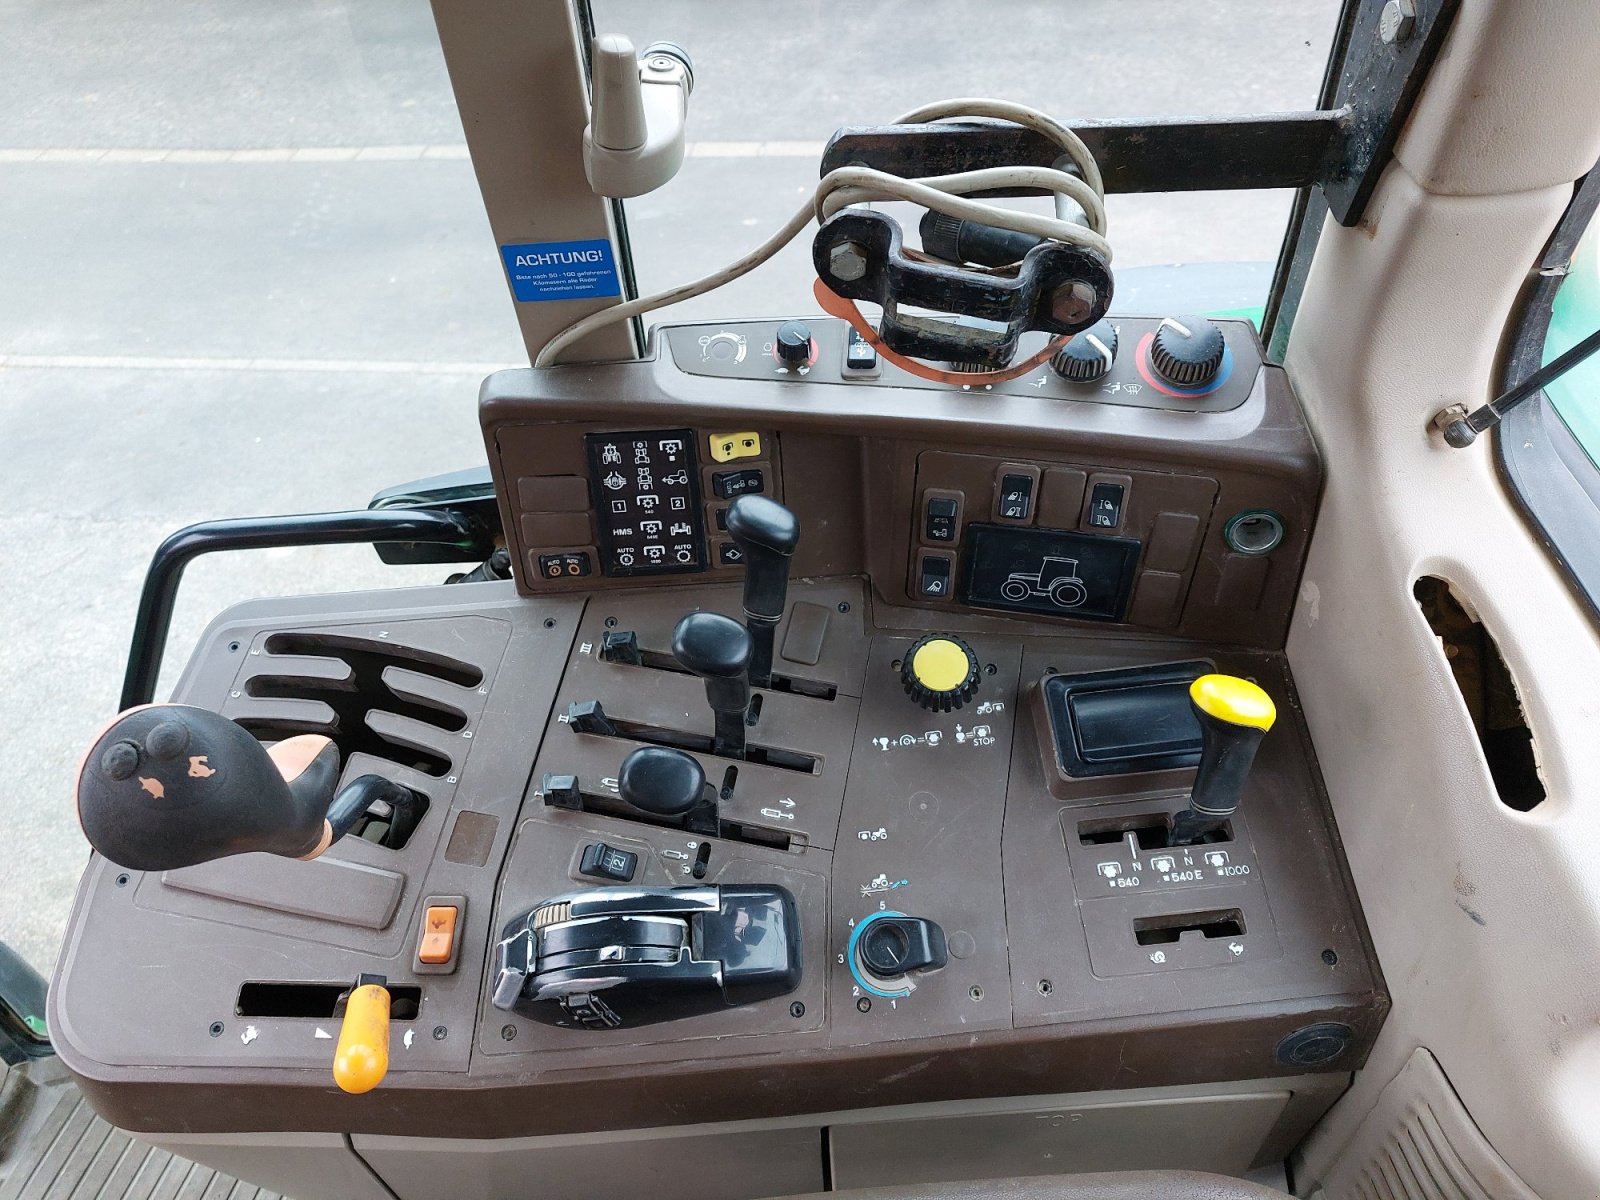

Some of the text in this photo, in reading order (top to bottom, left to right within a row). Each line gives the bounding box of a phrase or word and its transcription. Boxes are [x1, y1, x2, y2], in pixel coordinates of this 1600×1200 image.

[515, 250, 603, 266] ACHTUNG!
[674, 500, 681, 508] 2
[612, 527, 633, 536] HMS
[478, 686, 488, 695] F
[974, 737, 995, 746] STOP
[447, 775, 457, 784] B
[1184, 856, 1194, 866] N
[1132, 861, 1143, 872] N
[1225, 865, 1250, 877] 1000
[1117, 876, 1140, 888] 540
[879, 901, 886, 910] 5
[848, 918, 855, 927] 4
[837, 954, 844, 963] 3
[852, 986, 860, 996] 2
[891, 1000, 897, 1009] 1
